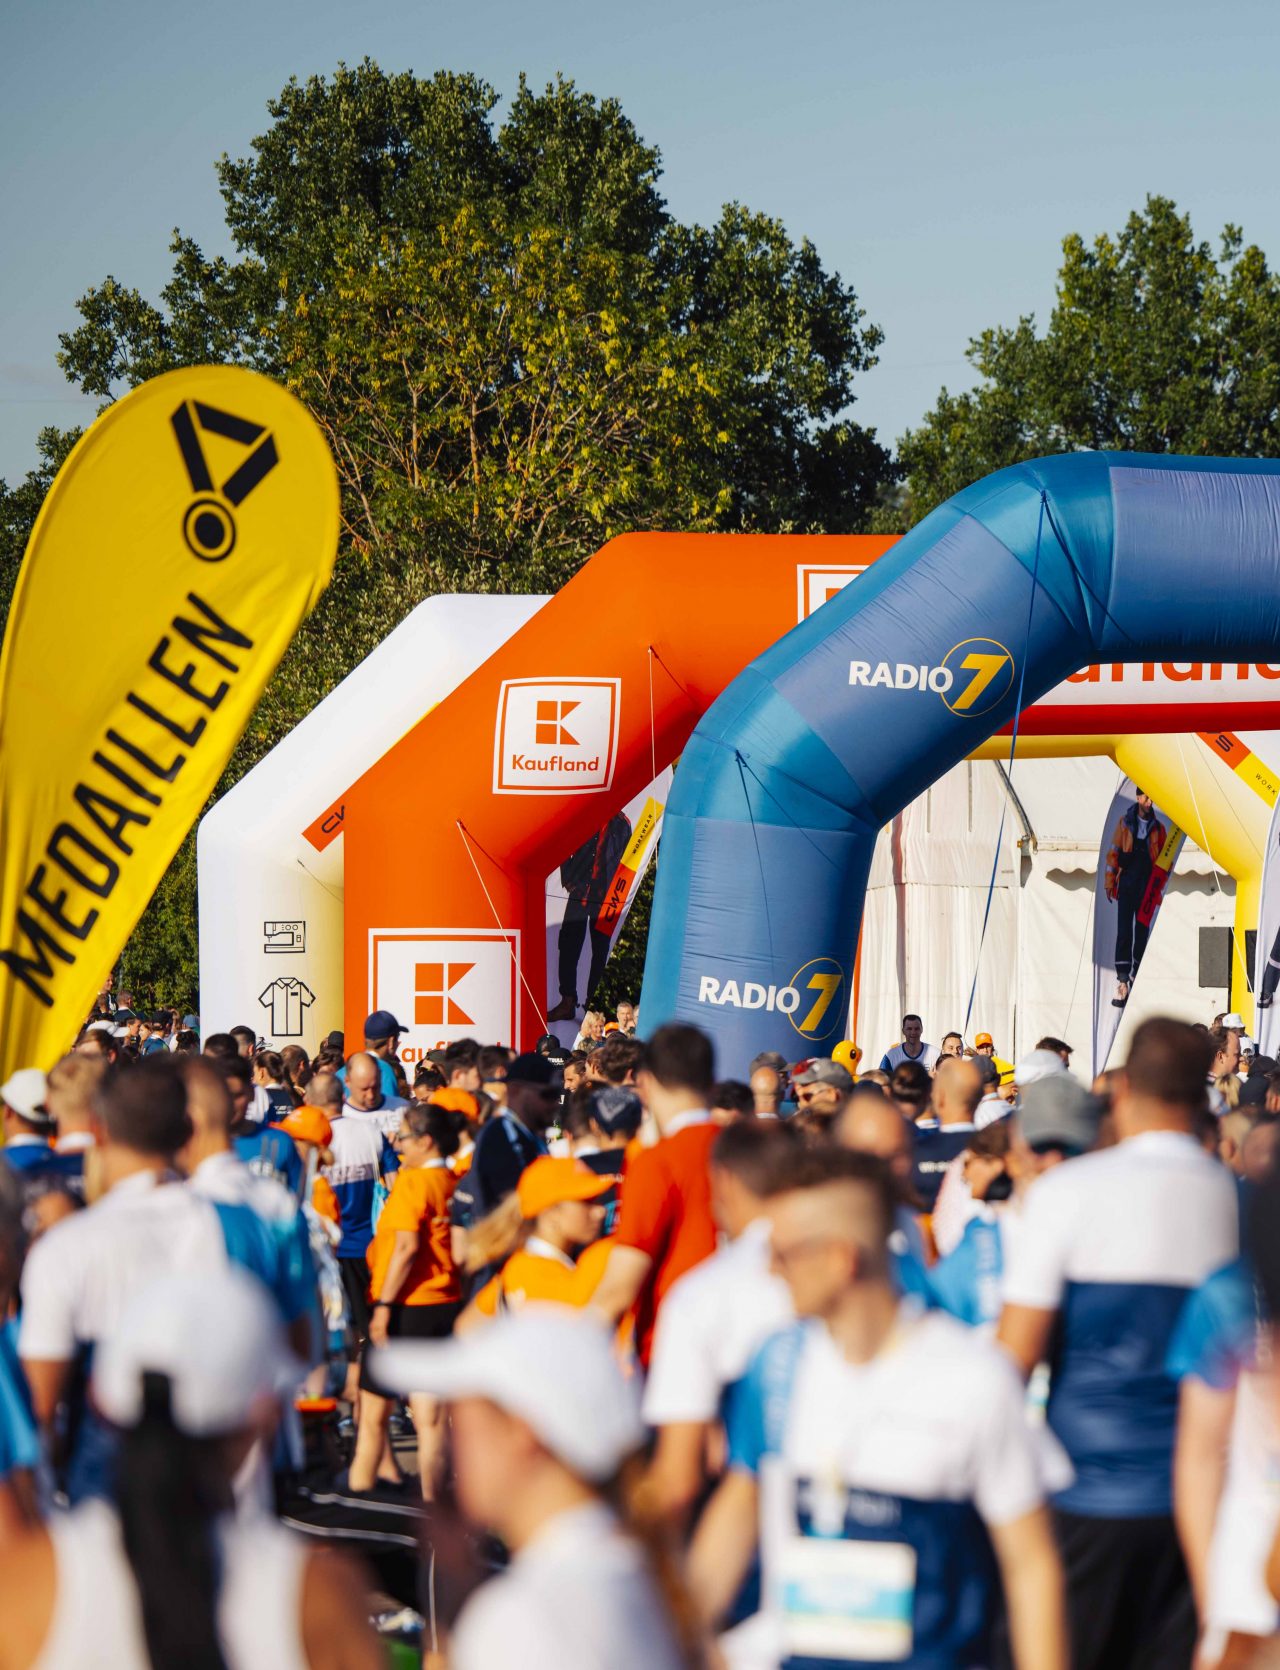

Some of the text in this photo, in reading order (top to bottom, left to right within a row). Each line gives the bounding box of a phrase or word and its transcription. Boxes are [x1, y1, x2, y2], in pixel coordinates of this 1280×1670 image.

[848, 660, 953, 693] RADIO
[951, 653, 1010, 709] 7
[512, 754, 599, 771] Kaufland
[1256, 773, 1277, 795] WORK
[1, 592, 254, 1007] MEDAILLEN
[632, 814, 653, 854] WORKWEAR
[605, 877, 627, 922] CWS
[698, 973, 843, 1031] RADIO 7
